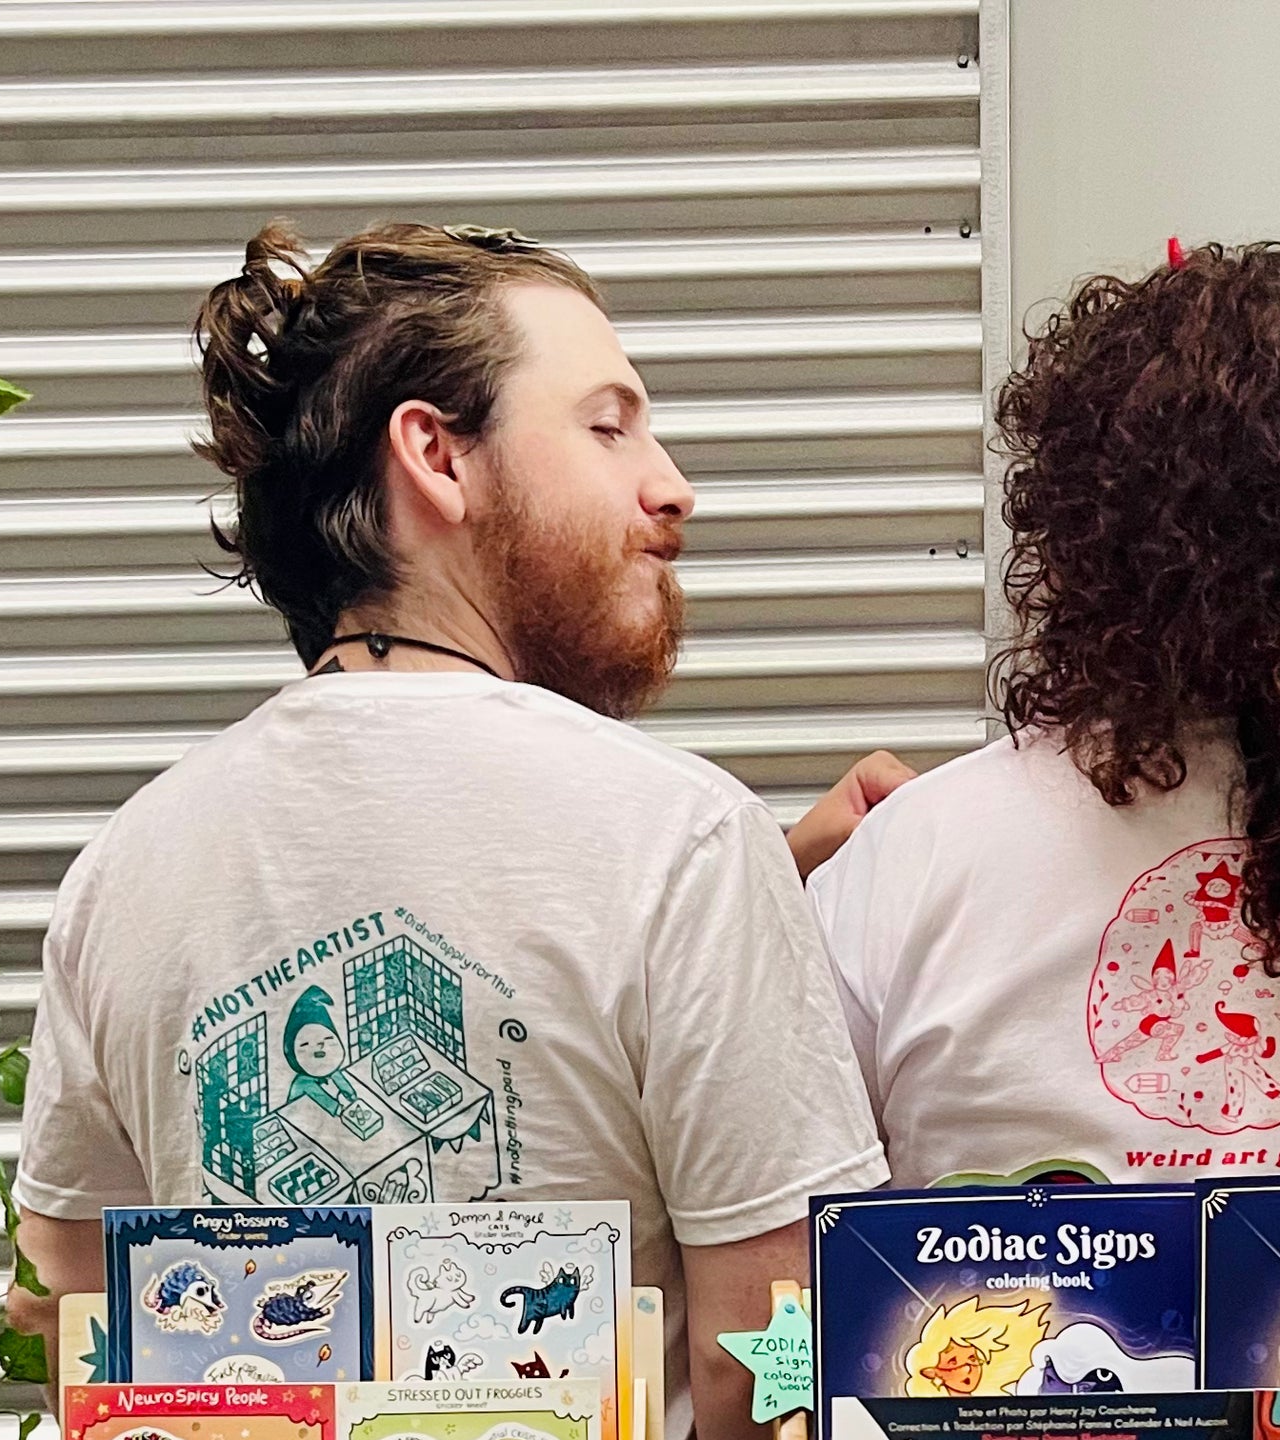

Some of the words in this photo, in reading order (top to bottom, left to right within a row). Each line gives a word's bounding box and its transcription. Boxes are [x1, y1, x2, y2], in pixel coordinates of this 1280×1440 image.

[192, 911, 386, 1043] #NOTTHEARTIST
[1126, 1149, 1212, 1167] Weird
[1222, 1149, 1268, 1166] art
[193, 1213, 232, 1231] Angry
[234, 1212, 290, 1229] Possums
[387, 1388, 450, 1402] STRESSED
[454, 1387, 481, 1400] OUT
[486, 1386, 543, 1400] FROGGIES
